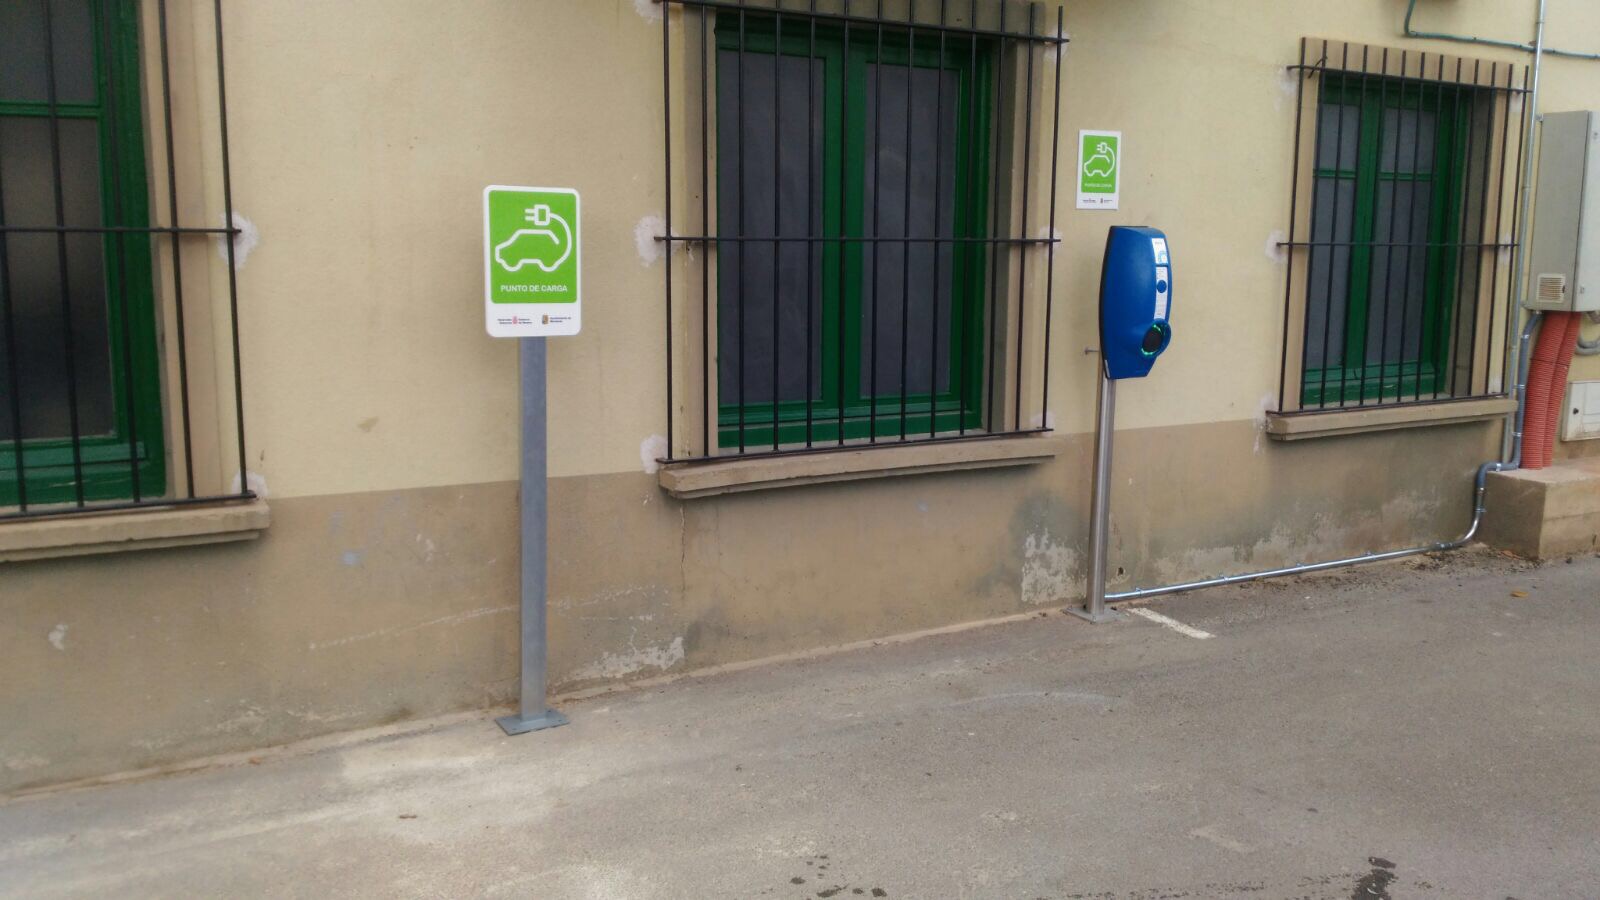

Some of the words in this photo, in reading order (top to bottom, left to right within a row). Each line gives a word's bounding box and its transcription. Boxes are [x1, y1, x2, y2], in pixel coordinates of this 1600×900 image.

[500, 284, 528, 292] PUNTO
[529, 284, 540, 292] DE
[541, 284, 568, 292] CARGA
